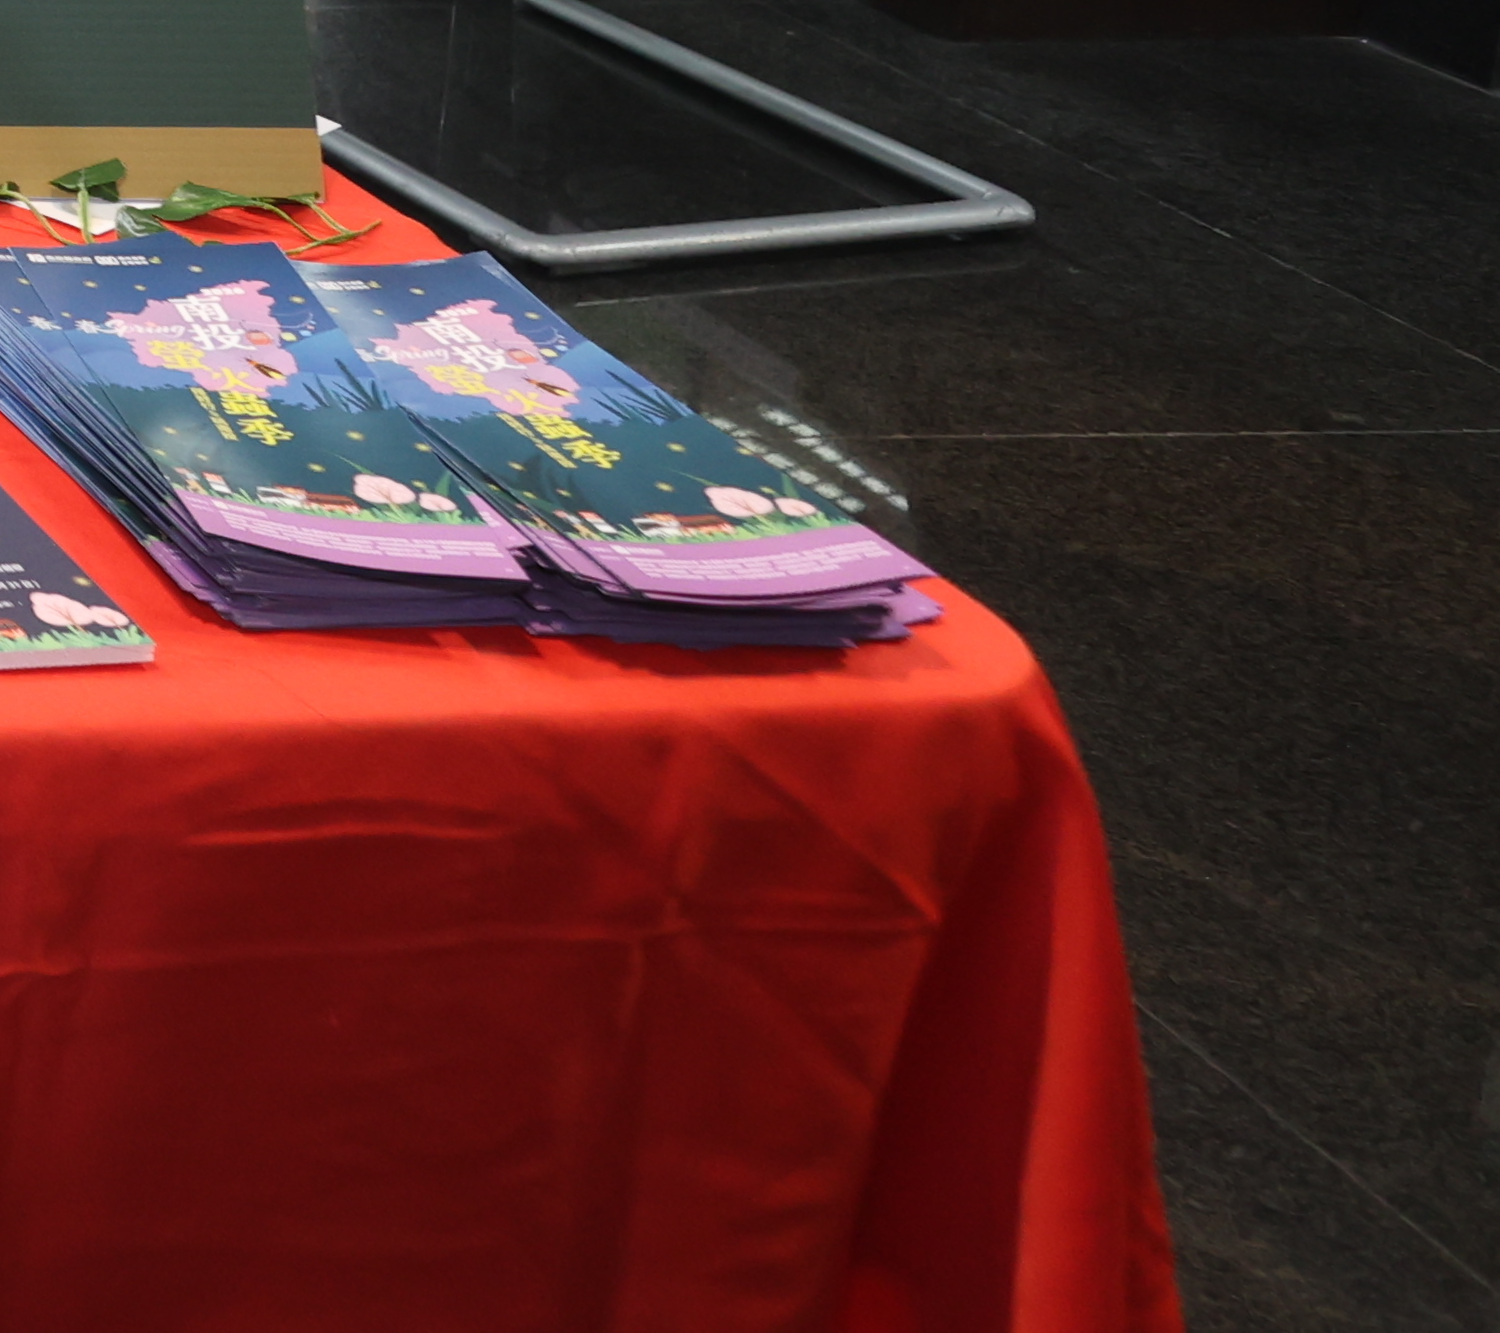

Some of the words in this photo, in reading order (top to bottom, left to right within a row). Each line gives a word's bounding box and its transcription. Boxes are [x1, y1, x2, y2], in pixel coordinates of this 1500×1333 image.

[169, 294, 257, 352] 南投
[414, 317, 528, 373] 南投
[148, 339, 295, 447] 螢火蟲季
[423, 364, 622, 470] 螢火蟲季
